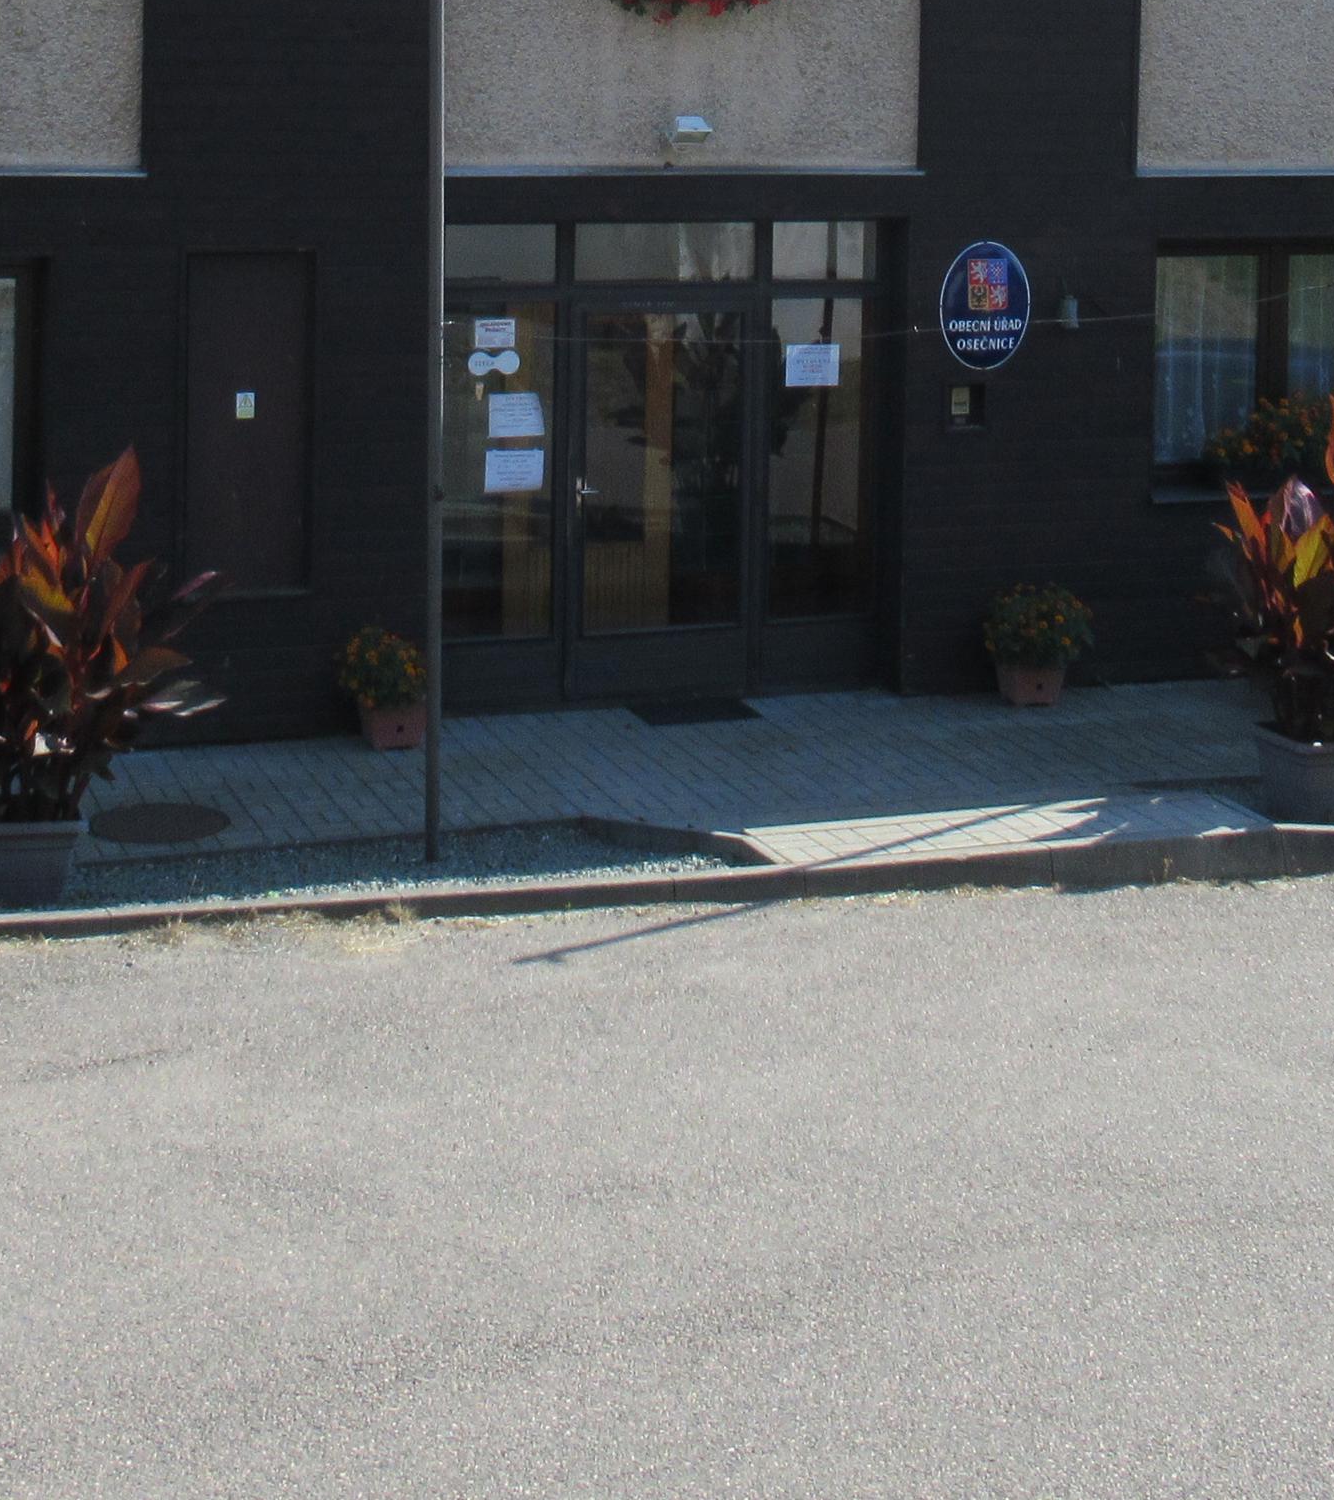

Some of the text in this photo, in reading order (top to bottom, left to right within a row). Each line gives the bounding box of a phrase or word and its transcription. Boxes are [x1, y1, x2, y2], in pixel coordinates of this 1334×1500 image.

[949, 315, 1022, 332] OBECNÍ ÚŘAD
[956, 336, 1015, 351] OSEČNICE
